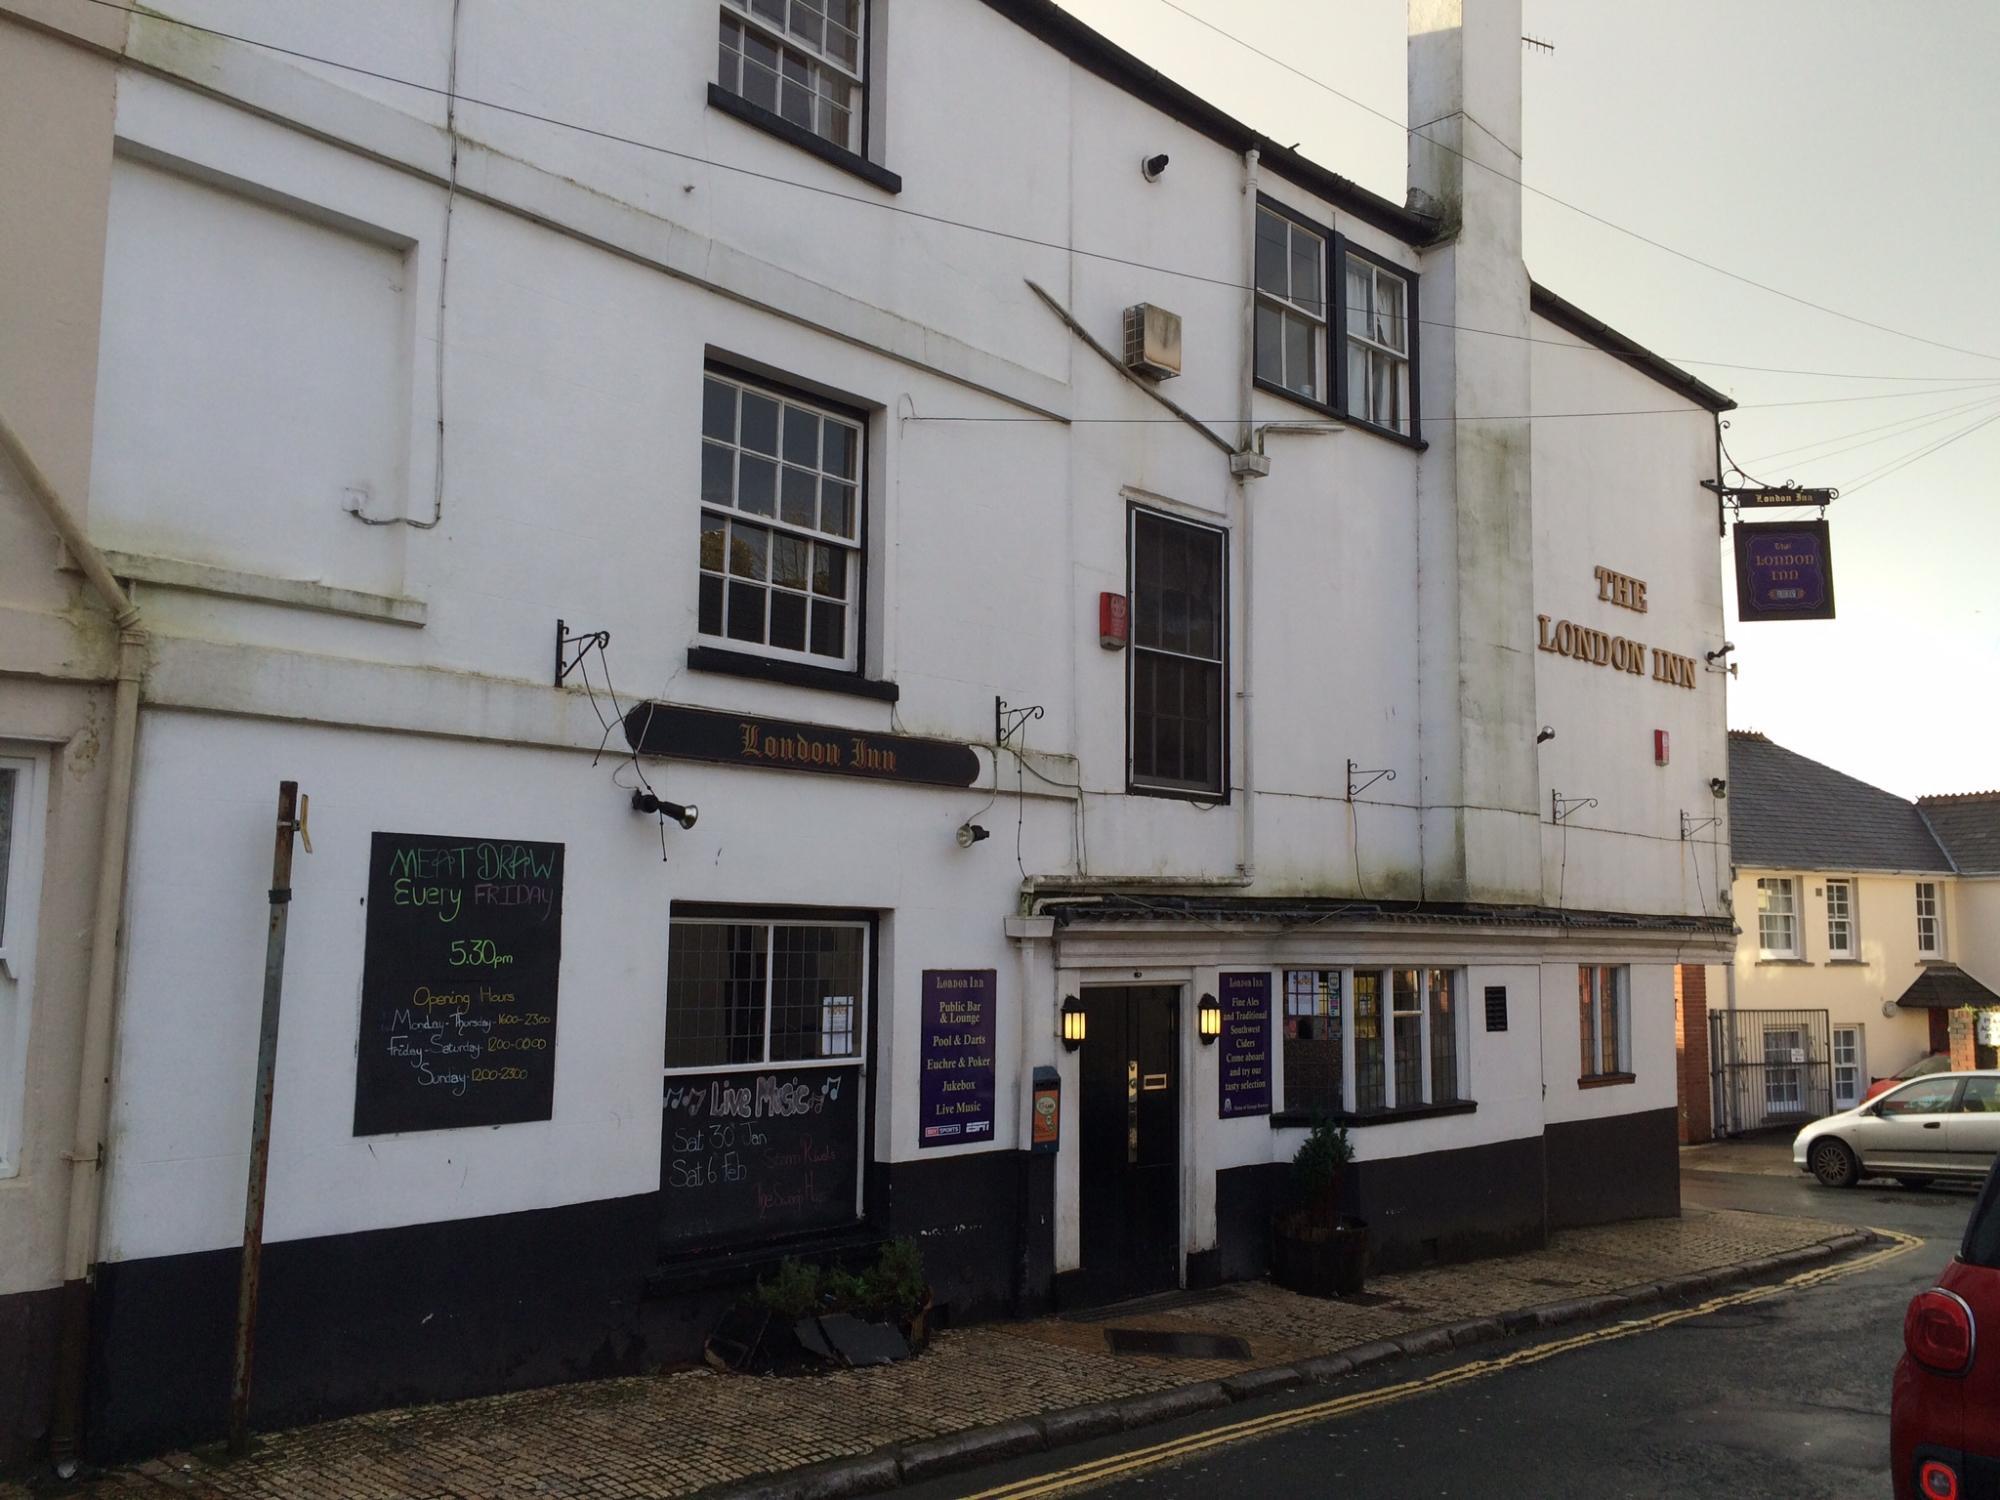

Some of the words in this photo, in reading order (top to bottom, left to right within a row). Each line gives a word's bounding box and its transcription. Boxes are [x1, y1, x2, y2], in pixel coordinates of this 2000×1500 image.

[1755, 493, 1792, 503] London
[1795, 493, 1814, 502] Inn
[1594, 565, 1648, 614] THE
[1537, 613, 1647, 676] LONDON
[1652, 648, 1697, 689] INN
[739, 722, 841, 766] London
[849, 737, 897, 773] Inn
[390, 848, 476, 880] MEAT
[476, 842, 555, 881] DRAW
[474, 883, 554, 921] FRIDAY
[936, 976, 968, 989] London
[970, 975, 984, 988] Inn
[413, 986, 471, 1014] Opening
[480, 986, 515, 1002] Hours
[1231, 997, 1245, 1007] Fine
[1246, 996, 1259, 1006] Ales
[939, 1001, 965, 1013] Public
[967, 1001, 981, 1012] Bar
[940, 1013, 948, 1024] &
[949, 1012, 980, 1025] Lounge
[1236, 1010, 1268, 1021] Traditional
[1230, 1024, 1261, 1035] Southwest
[933, 1035, 952, 1047] Pool
[953, 1034, 962, 1046] &
[963, 1034, 986, 1046] Darts
[1235, 1038, 1256, 1049] Ciders
[927, 1058, 957, 1071] Euchre
[958, 1058, 966, 1069] &
[968, 1056, 991, 1068] Poker
[1226, 1052, 1244, 1063] Come
[1245, 1051, 1265, 1062] aboard
[1230, 1067, 1241, 1077] and
[1242, 1067, 1251, 1078] try
[1251, 1067, 1262, 1075] our
[942, 1080, 976, 1093] Jukebox
[1225, 1083, 1240, 1093] tasty
[1240, 1080, 1266, 1090] selection
[709, 1079, 752, 1118] Live
[755, 1075, 810, 1118] Music
[936, 1103, 954, 1116] Live
[956, 1102, 981, 1114] Music
[966, 1121, 990, 1133] ESPN
[671, 1127, 705, 1153] Sat
[709, 1124, 735, 1149] 30
[740, 1121, 768, 1146] Jan
[669, 1159, 706, 1188] Sat
[707, 1156, 718, 1184] 6
[722, 1151, 747, 1183] Feb
